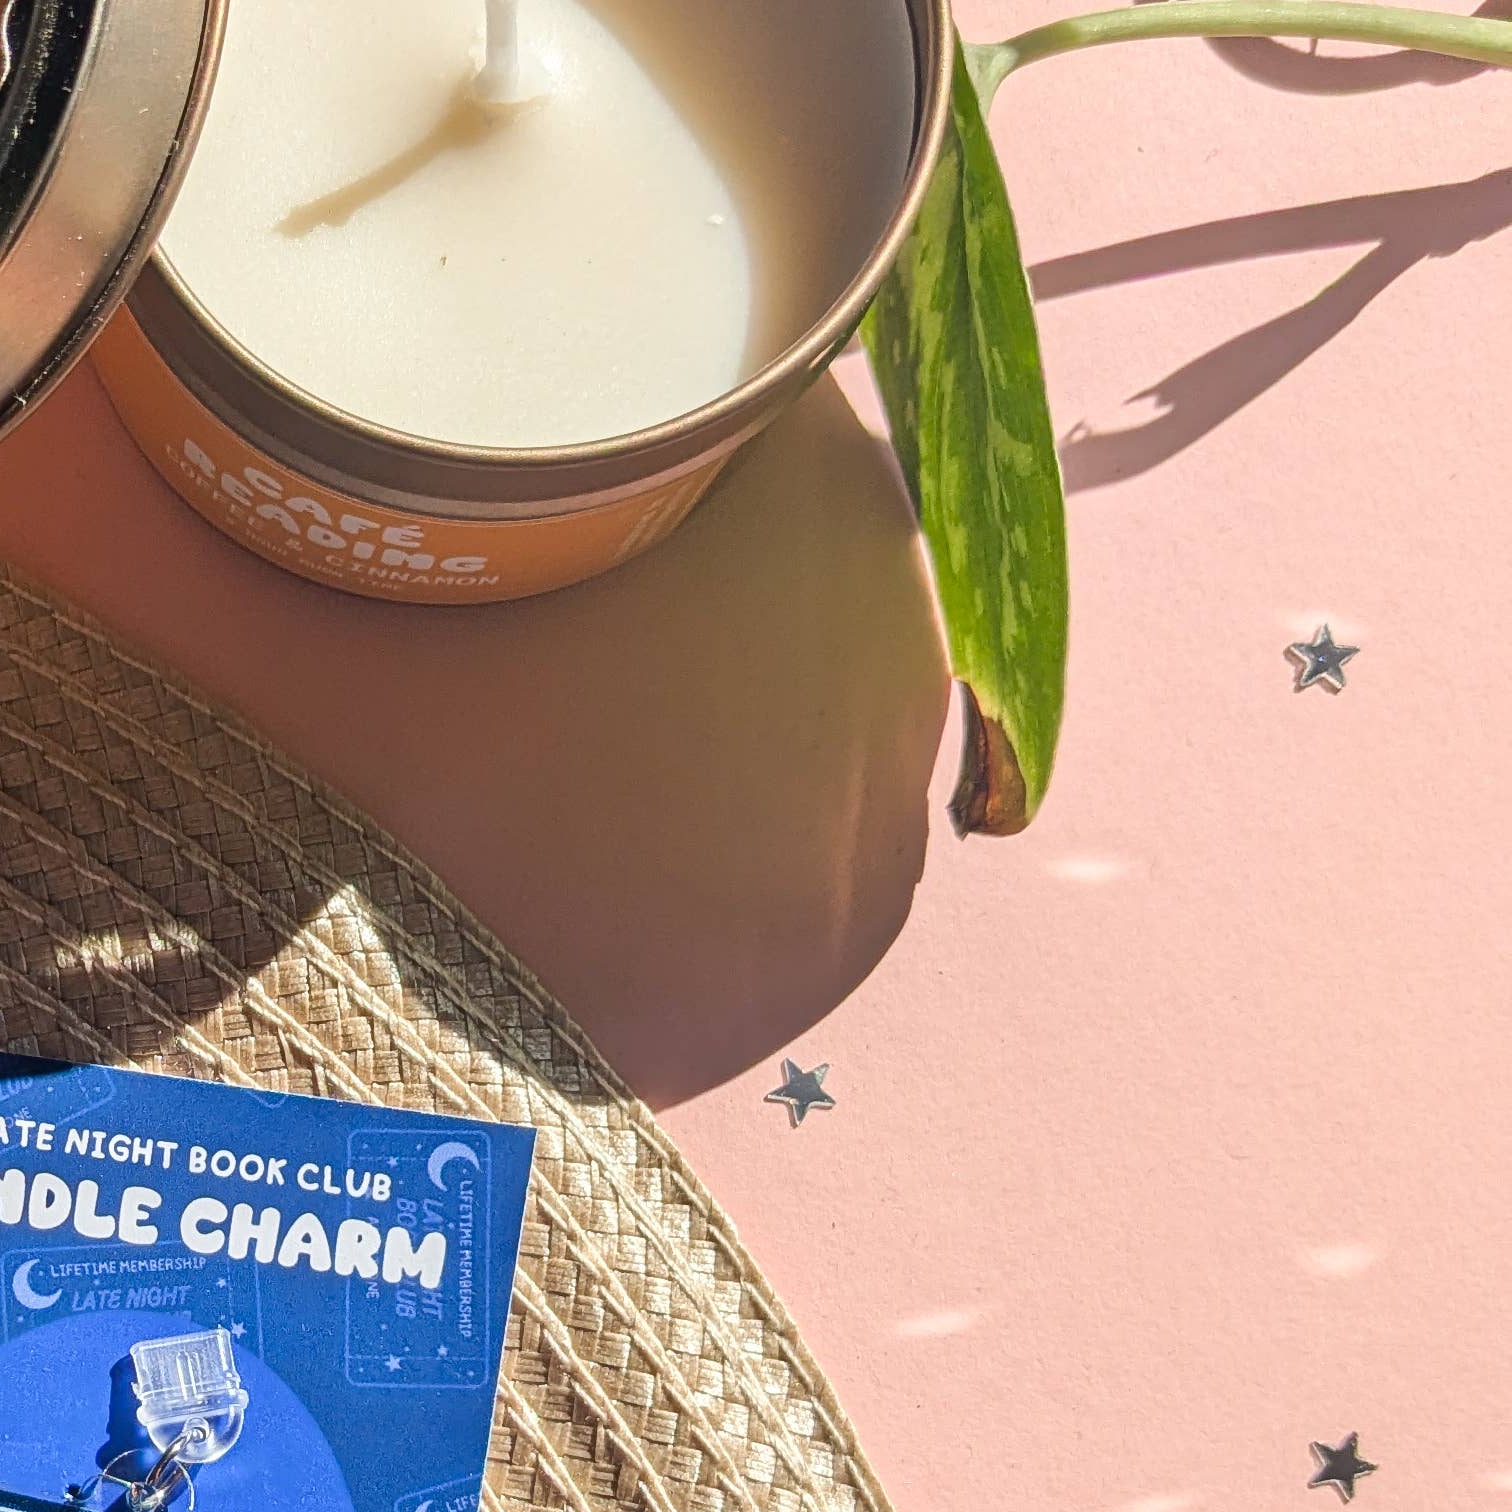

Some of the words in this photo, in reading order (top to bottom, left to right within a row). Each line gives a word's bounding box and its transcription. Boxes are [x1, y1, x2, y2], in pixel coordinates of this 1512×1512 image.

[183, 438, 488, 573] READING
[326, 554, 500, 586] CINNAMON
[64, 1128, 179, 1169] NIGHT
[188, 1145, 288, 1186] BOOK
[297, 1162, 392, 1201] CLUB
[179, 1197, 447, 1290] CHARM
[459, 1180, 474, 1246] LIFETIME
[50, 1262, 117, 1277] LIFETIME
[120, 1257, 206, 1274] MEMBERSHIP
[71, 1288, 122, 1312] LATE
[126, 1285, 191, 1308] NIGHT
[458, 1249, 474, 1337] MEMBERSHIP
